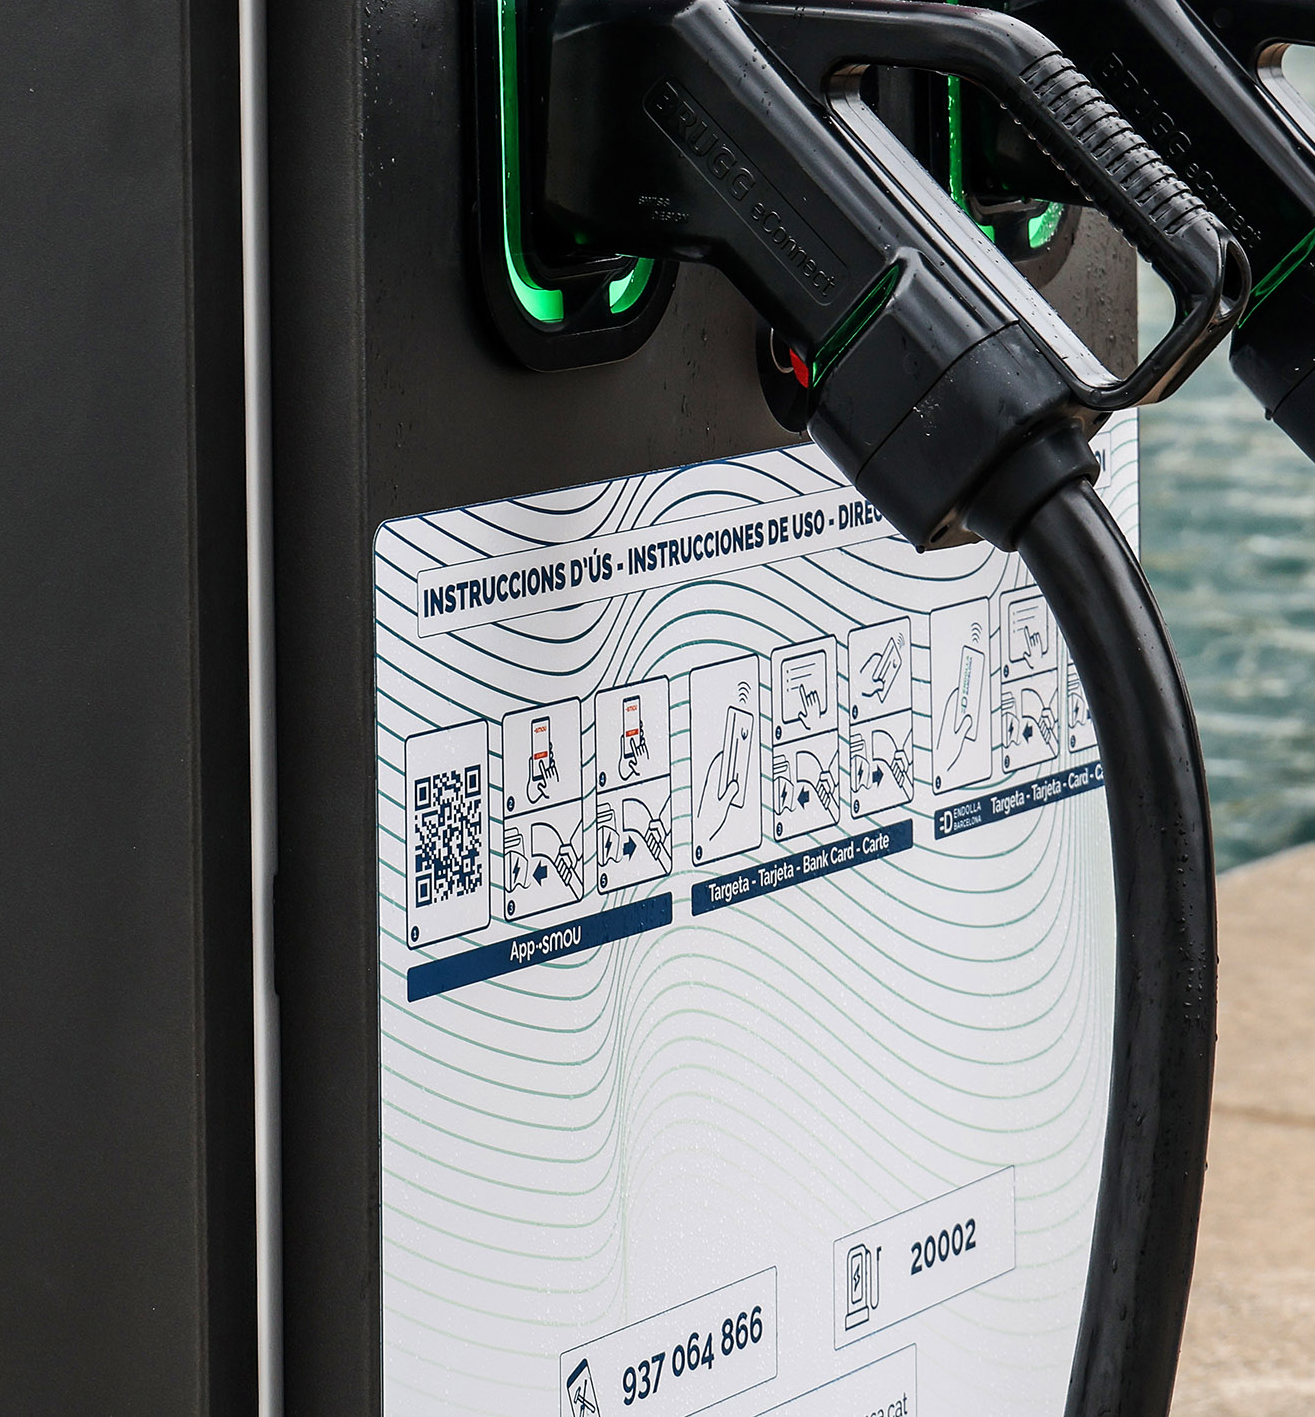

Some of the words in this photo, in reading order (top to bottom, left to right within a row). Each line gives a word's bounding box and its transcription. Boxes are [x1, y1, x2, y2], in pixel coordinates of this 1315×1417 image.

[653, 80, 756, 202] BRUGG
[749, 201, 836, 297] eConnect
[423, 561, 566, 618] INSTRUCCIONS
[570, 547, 613, 588] D'ÚS
[627, 521, 764, 576] INSTRUCCIONES
[768, 515, 789, 546] DE
[792, 508, 825, 540] USO
[952, 801, 982, 819] ENDOLLA
[990, 791, 1025, 814] Targeta
[1030, 779, 1062, 802] Tarjeta
[1067, 767, 1089, 790] Card
[953, 814, 982, 831] BARCELONA
[708, 875, 750, 902] Targeta
[757, 862, 794, 888] Tarjeta
[802, 849, 828, 874] Bank
[829, 840, 854, 865] Card
[862, 833, 890, 855] Carte
[509, 940, 535, 964] App
[910, 1217, 977, 1276] 20002
[622, 1351, 666, 1406] 937
[672, 1332, 715, 1378] 064
[721, 1305, 763, 1357] 866
